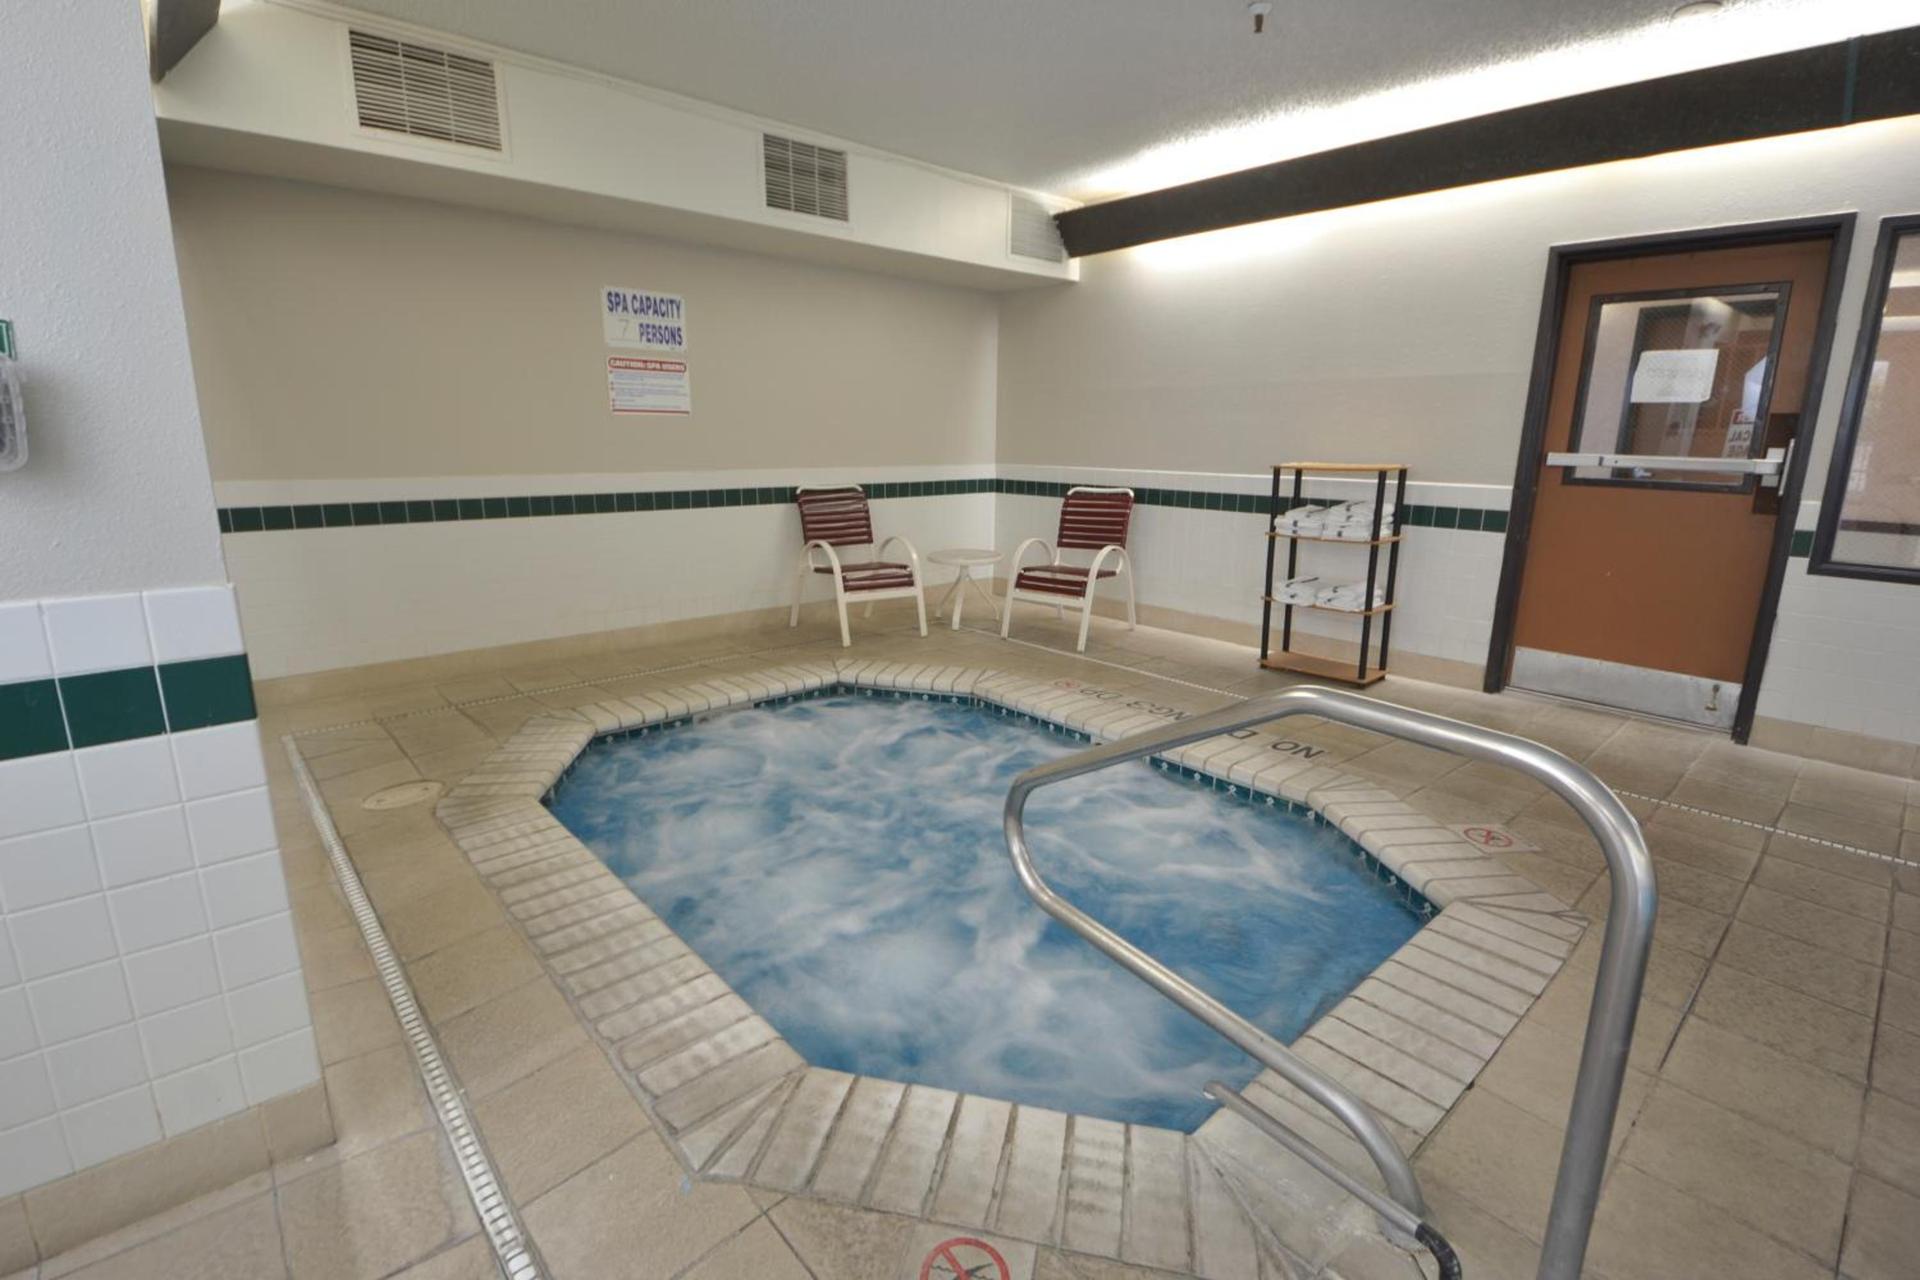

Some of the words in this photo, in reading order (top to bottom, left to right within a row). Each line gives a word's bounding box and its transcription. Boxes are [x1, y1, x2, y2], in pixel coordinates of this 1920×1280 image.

[607, 291, 628, 313] SPA
[632, 293, 681, 319] CAPACITY
[639, 322, 683, 346] PERSONS
